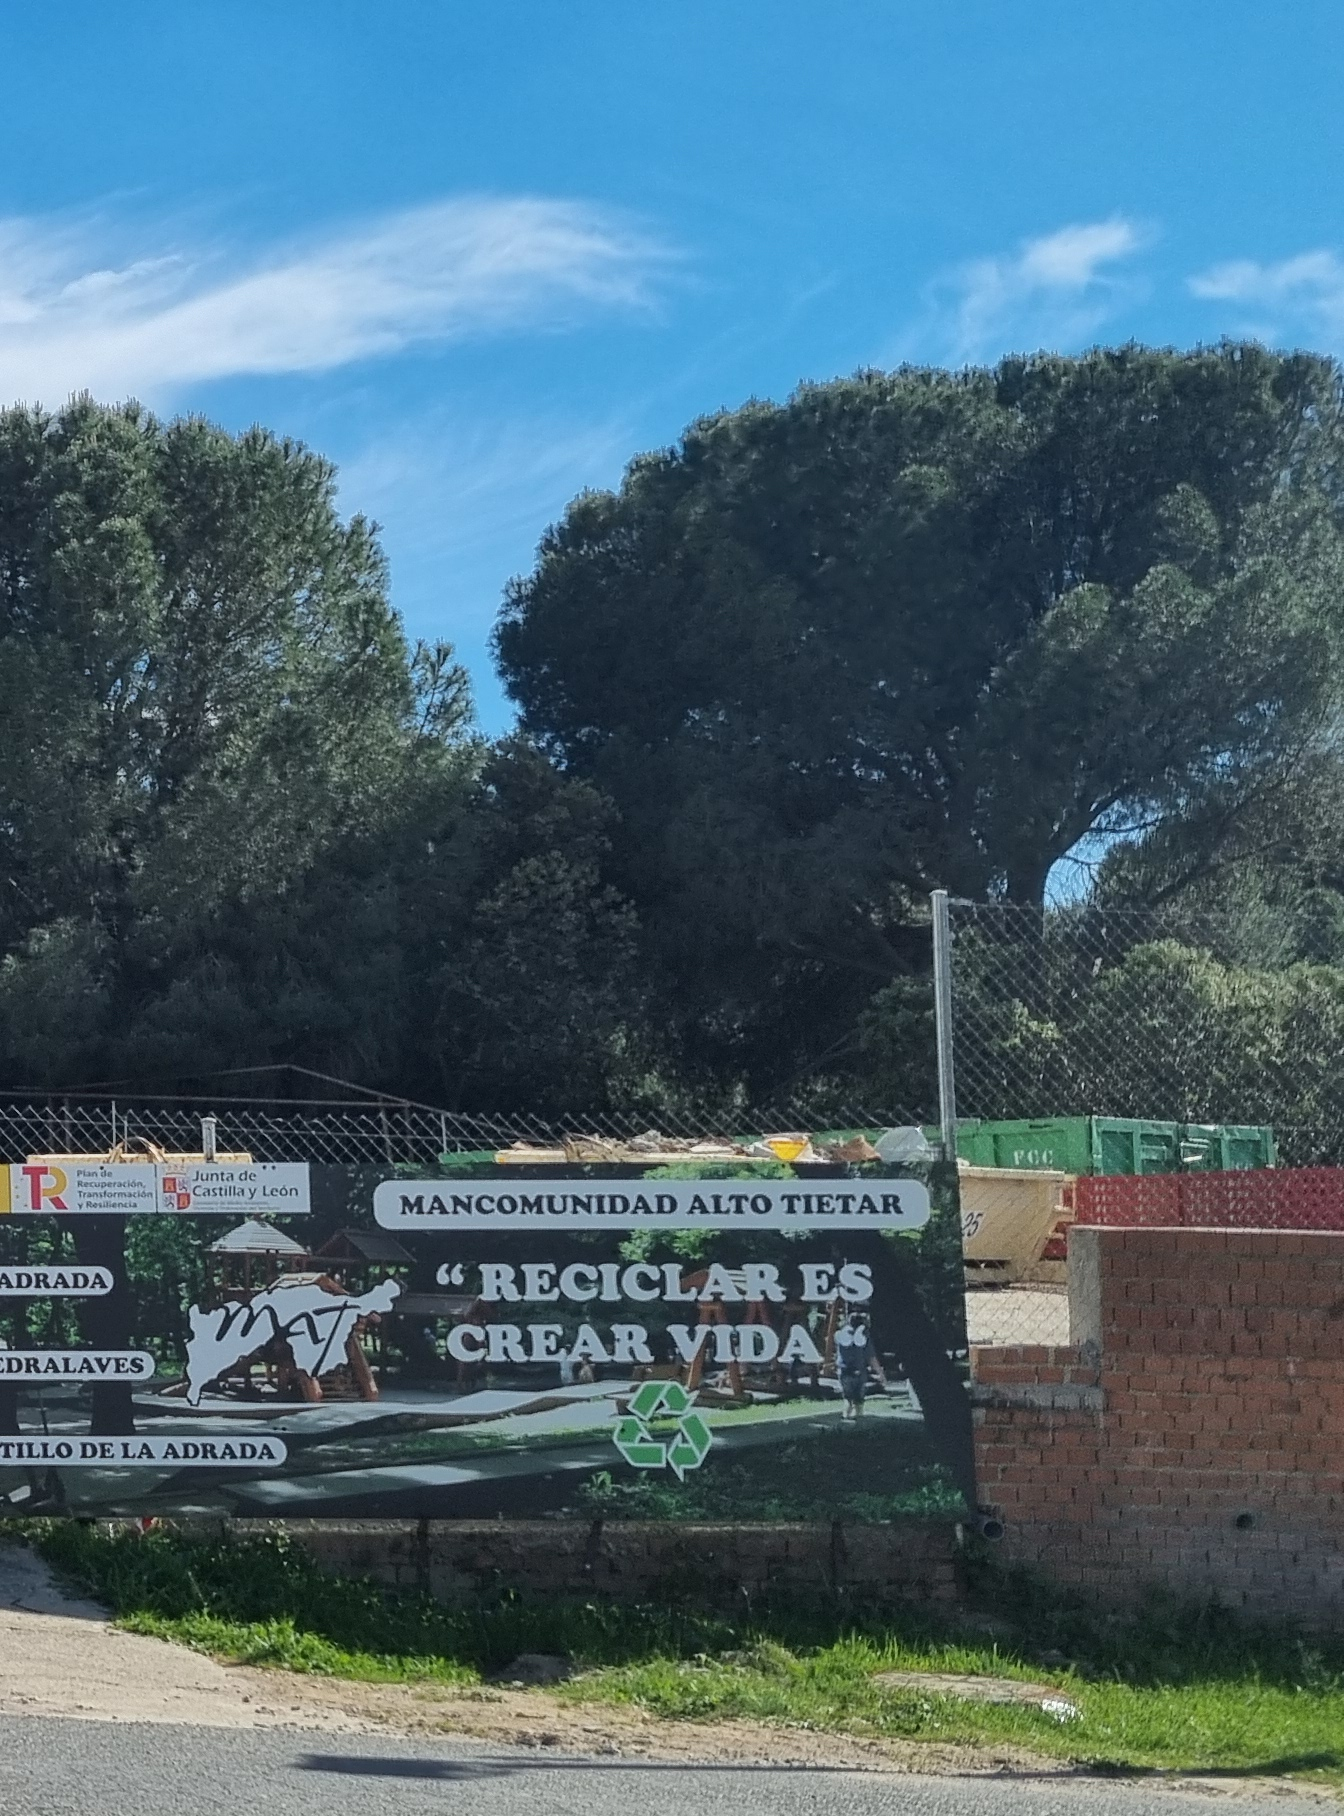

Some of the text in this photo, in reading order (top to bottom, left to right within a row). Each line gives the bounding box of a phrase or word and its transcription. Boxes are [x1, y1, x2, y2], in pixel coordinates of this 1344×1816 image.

[76, 1169, 113, 1178] Plan de
[191, 1169, 257, 1182] Junta de
[76, 1180, 146, 1189] Recuperación,
[77, 1189, 153, 1199] Transformación
[192, 1184, 300, 1200] Castilla y León
[77, 1200, 138, 1210] y Resiliencia
[399, 1193, 904, 1216] MANCOMUNIDAD ALTO TIETAR
[477, 1262, 786, 1303] RECICLAR
[798, 1262, 873, 1303] ES
[445, 1322, 655, 1363] CREAR
[666, 1322, 825, 1363] VIDA
[79, 1441, 115, 1460] DE
[120, 1441, 155, 1460] LA
[162, 1441, 277, 1460] ADRADA
